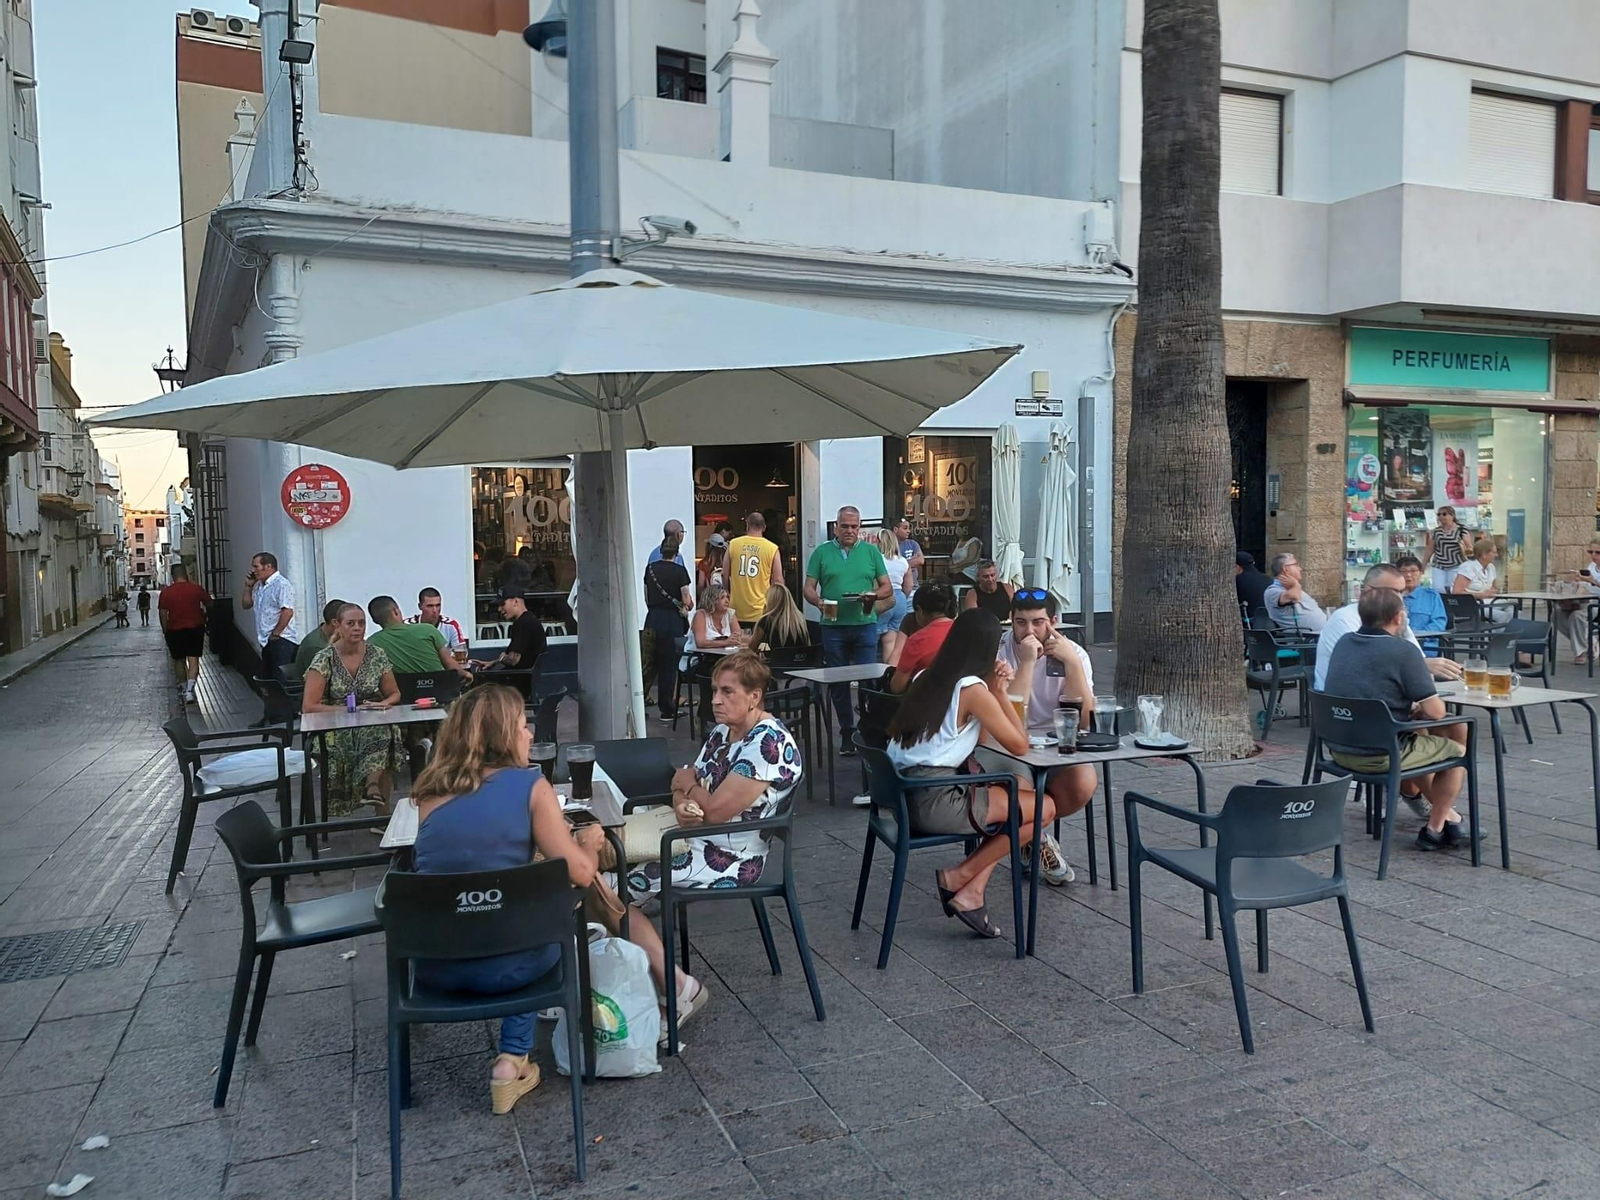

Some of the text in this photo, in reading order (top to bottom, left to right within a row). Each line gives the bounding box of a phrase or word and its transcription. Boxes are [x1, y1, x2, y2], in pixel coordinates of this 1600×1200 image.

[1392, 349, 1511, 372] PERFUMERÍA
[694, 466, 739, 491] 00
[694, 493, 738, 503] NTADITOS
[908, 495, 971, 523] 100
[738, 554, 760, 578] 16
[1331, 705, 1352, 717] 100
[1284, 799, 1315, 814] 100
[456, 888, 502, 906] 100
[455, 903, 503, 913] MONTADITOS
